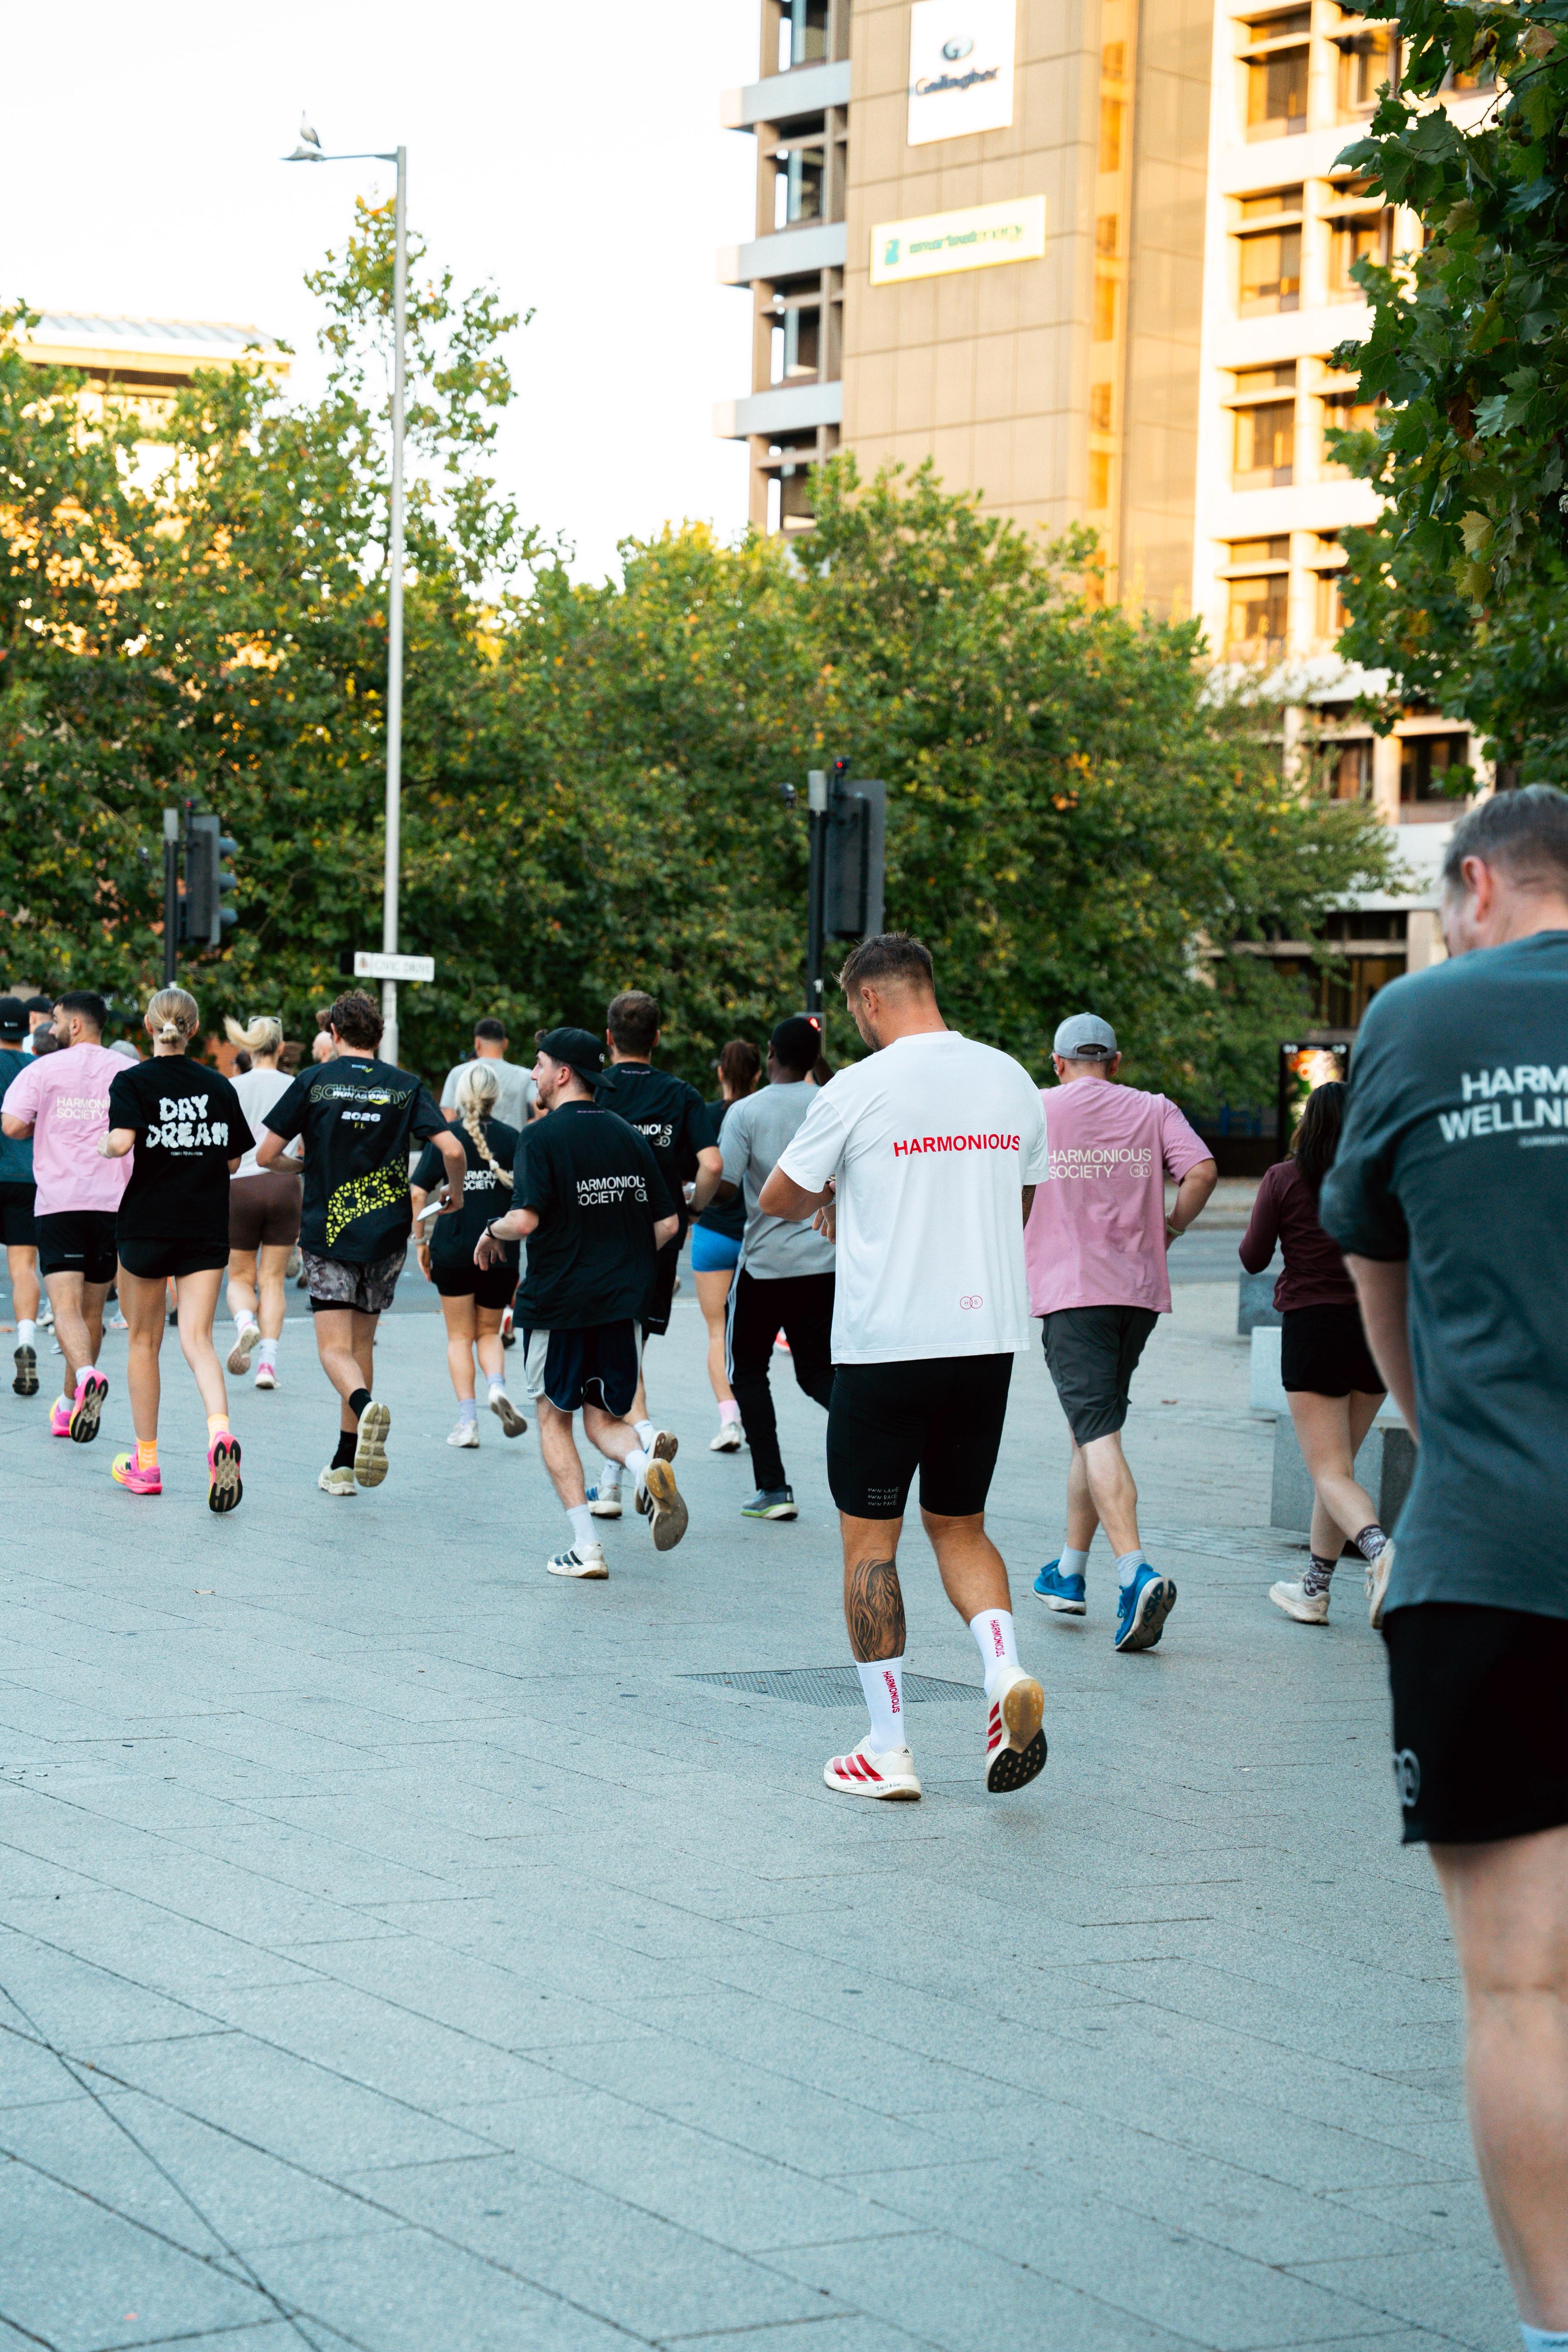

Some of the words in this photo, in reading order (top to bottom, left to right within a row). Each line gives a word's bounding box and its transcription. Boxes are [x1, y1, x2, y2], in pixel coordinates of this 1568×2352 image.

[56, 1107, 105, 1120] SOCIETY
[159, 1094, 209, 1121] DAY
[341, 1111, 381, 1122] 2026
[1438, 1097, 1568, 1142] WELLN
[146, 1122, 228, 1148] DREAM
[893, 1134, 1020, 1157] HARMONIOUS
[1048, 1148, 1151, 1164] HARMONIOUS
[1049, 1165, 1114, 1180] SOCIETY
[463, 1180, 496, 1191] OCIETY
[989, 1619, 1005, 1657] HARMONIOUS
[882, 1670, 900, 1713] HARMONIOUS
